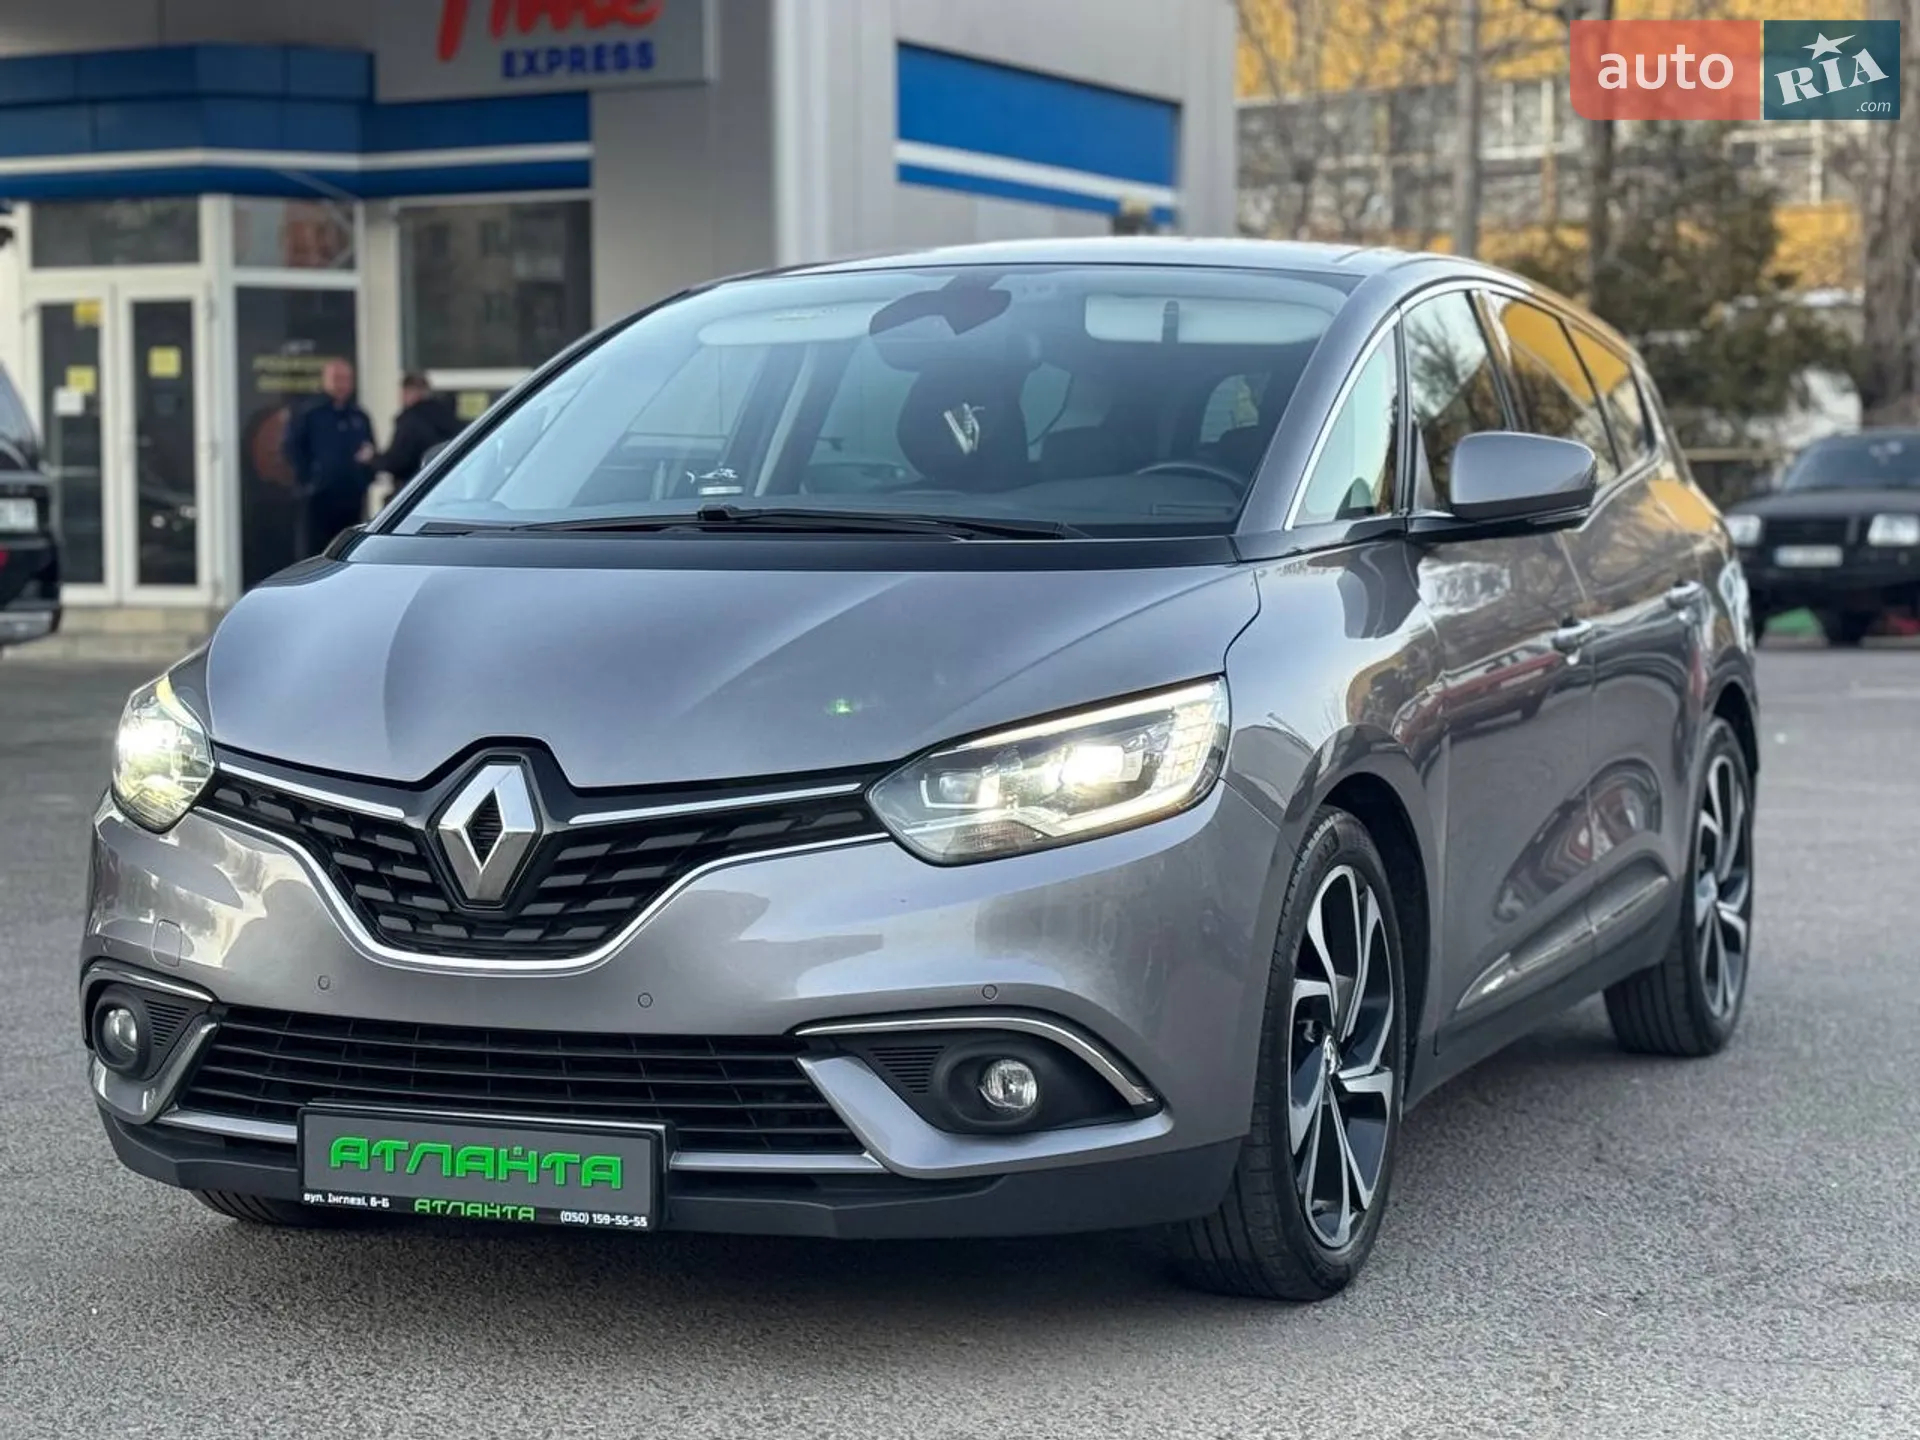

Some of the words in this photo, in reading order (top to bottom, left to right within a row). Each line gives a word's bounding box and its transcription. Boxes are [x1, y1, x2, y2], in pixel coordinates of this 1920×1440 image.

[502, 41, 657, 80] EXPRESS
[329, 1136, 623, 1190] АТЛАНТА
[414, 1198, 536, 1222] АТЛАНТА
[559, 1209, 590, 1226] (050)
[591, 1212, 649, 1228] 159-55-55
